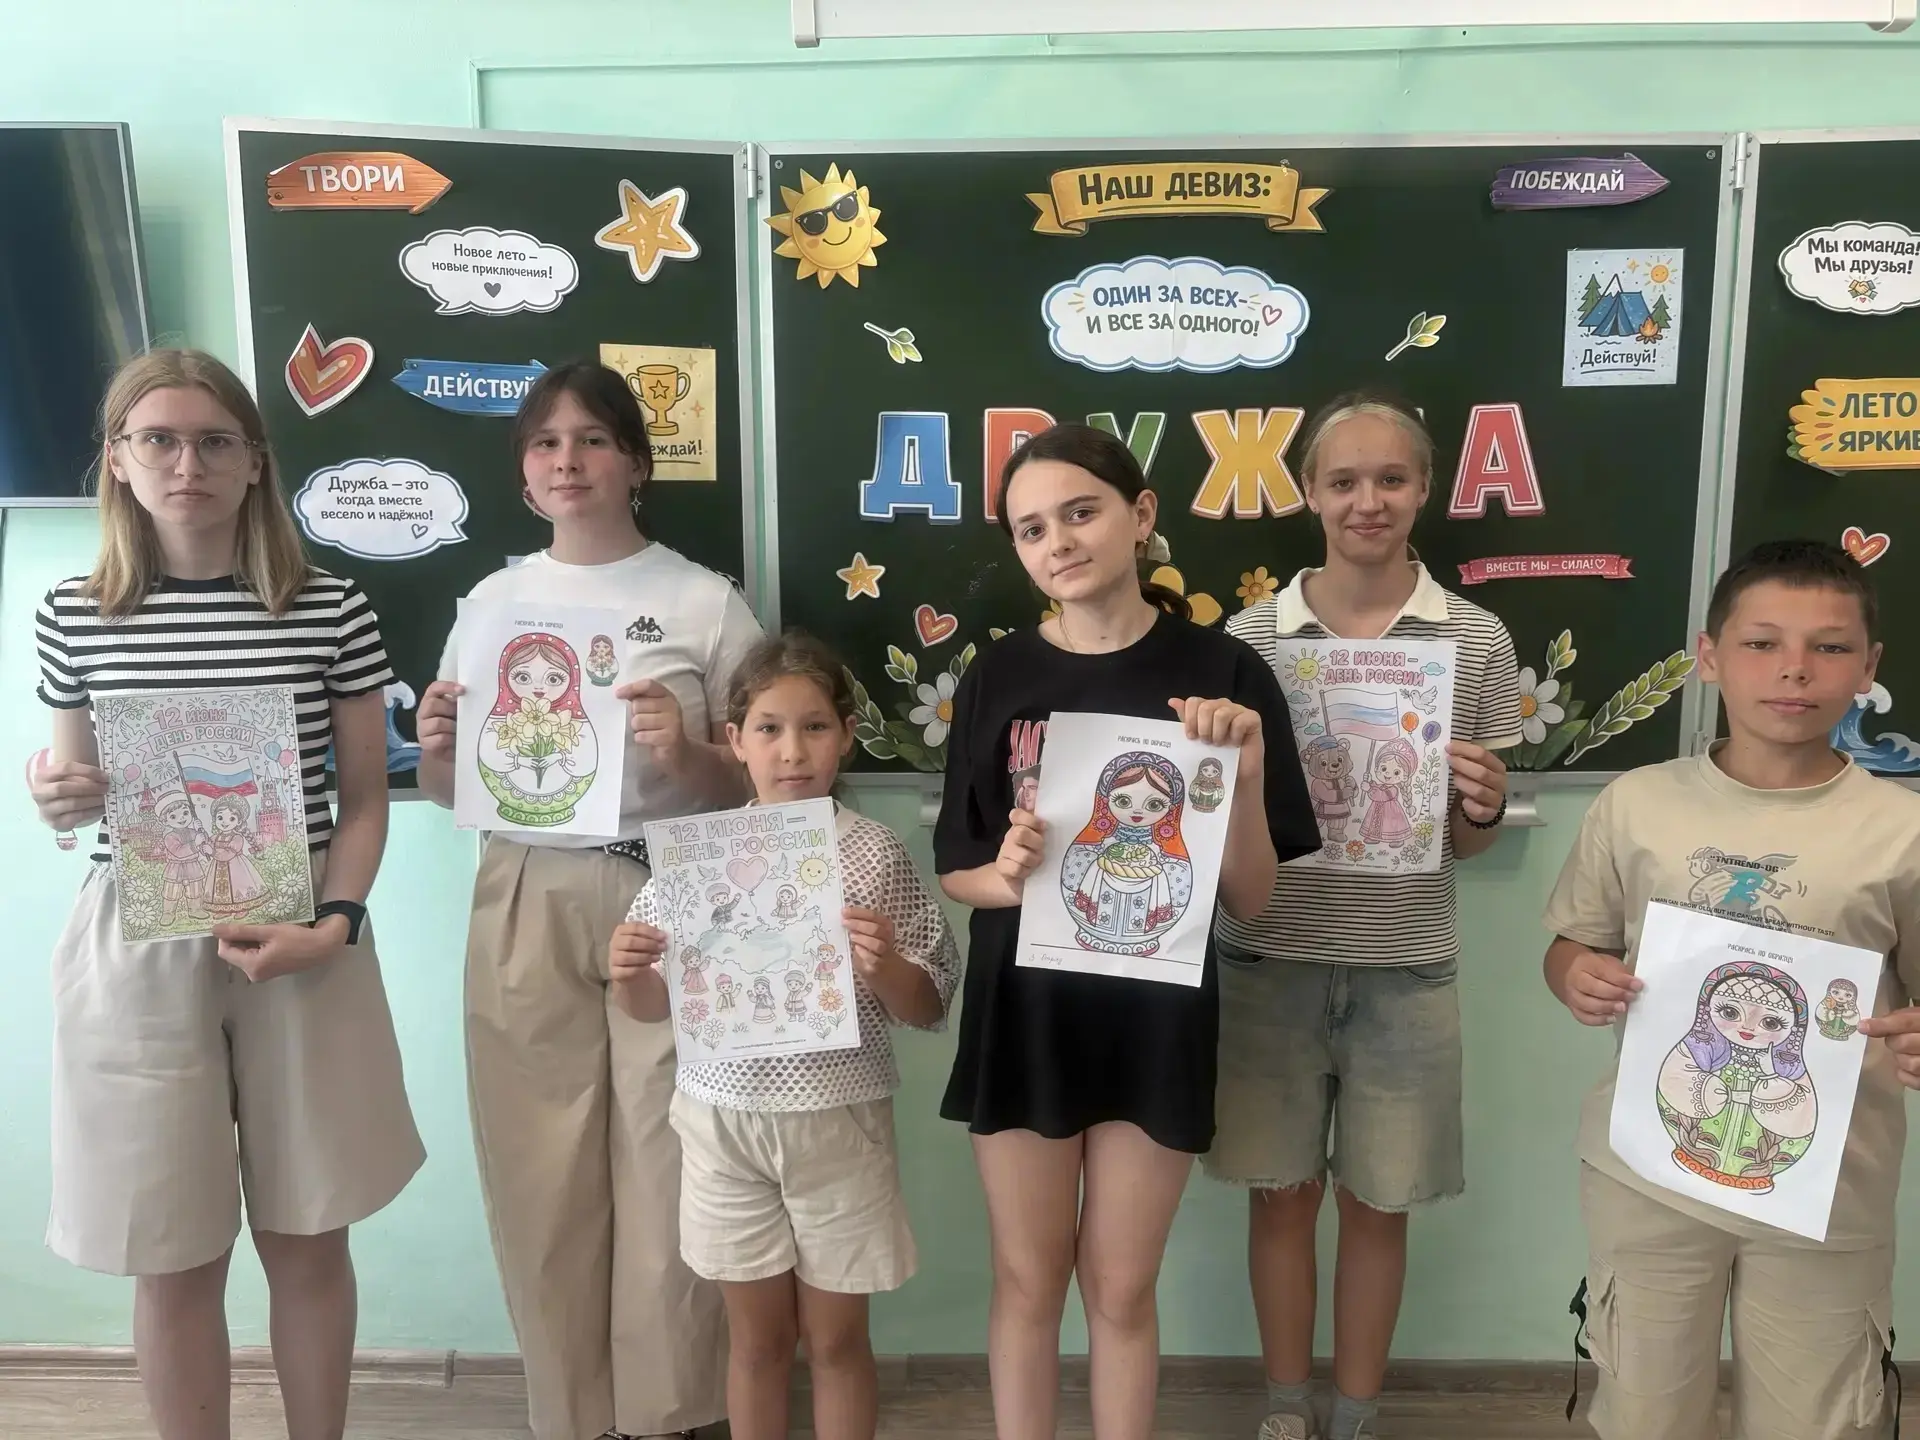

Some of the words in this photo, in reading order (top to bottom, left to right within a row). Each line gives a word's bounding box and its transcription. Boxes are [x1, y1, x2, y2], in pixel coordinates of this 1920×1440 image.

[299, 165, 406, 193] ТВОРИ
[1078, 173, 1154, 206] НАШ
[1165, 171, 1272, 202] ДЕВИЗ:
[1510, 168, 1625, 194] ПОБЕЖДАЙ
[453, 243, 493, 259] Новое
[497, 250, 527, 262] лето
[1807, 237, 1839, 255] Мы
[1843, 240, 1920, 256] команда!
[432, 261, 469, 273] новые
[472, 264, 553, 280] приключения!
[1814, 256, 1846, 274] Мы
[1849, 259, 1914, 275] друзья!
[1092, 285, 1151, 308] ОДИН
[1158, 285, 1184, 304] ЗА
[1086, 315, 1102, 334] И
[1108, 313, 1143, 332] ВСЕ
[1148, 313, 1174, 330] ЗА
[1178, 315, 1260, 337] ОДНОГО!
[1580, 348, 1657, 368] Действуй!
[1839, 391, 1918, 419] ЛЕТО
[650, 438, 703, 458] еждай!
[327, 476, 389, 493] Дружба
[405, 480, 429, 491] это
[336, 495, 375, 506] когда
[379, 496, 423, 506] вместе
[320, 509, 364, 520] весело
[367, 510, 376, 520] и
[379, 509, 434, 521] надёжно!
[1486, 560, 1527, 573] ВМЕСТЕ
[1530, 560, 1550, 571] МЫ
[1561, 558, 1594, 570] СИЛА!
[625, 629, 663, 643] Kappa
[1329, 648, 1350, 666] 12
[1353, 650, 1406, 667] ИЮНЯ
[1323, 667, 1363, 685] ДЕНЬ
[1365, 668, 1426, 687] РОССИИ
[152, 706, 184, 730] 12
[185, 708, 228, 724] ИЮНЯ
[153, 728, 193, 752] ДЕНЬ
[195, 725, 253, 742] РОССИИ
[668, 821, 700, 844] 12
[705, 811, 785, 840] ИЮНЯ
[661, 841, 726, 869] ДЕНЬ
[730, 827, 828, 857] РОССИИ
[1680, 901, 1697, 909] GROW
[1713, 907, 1727, 915] BUT
[1765, 917, 1786, 928] SPEAK
[1786, 921, 1817, 933] WITHOUT
